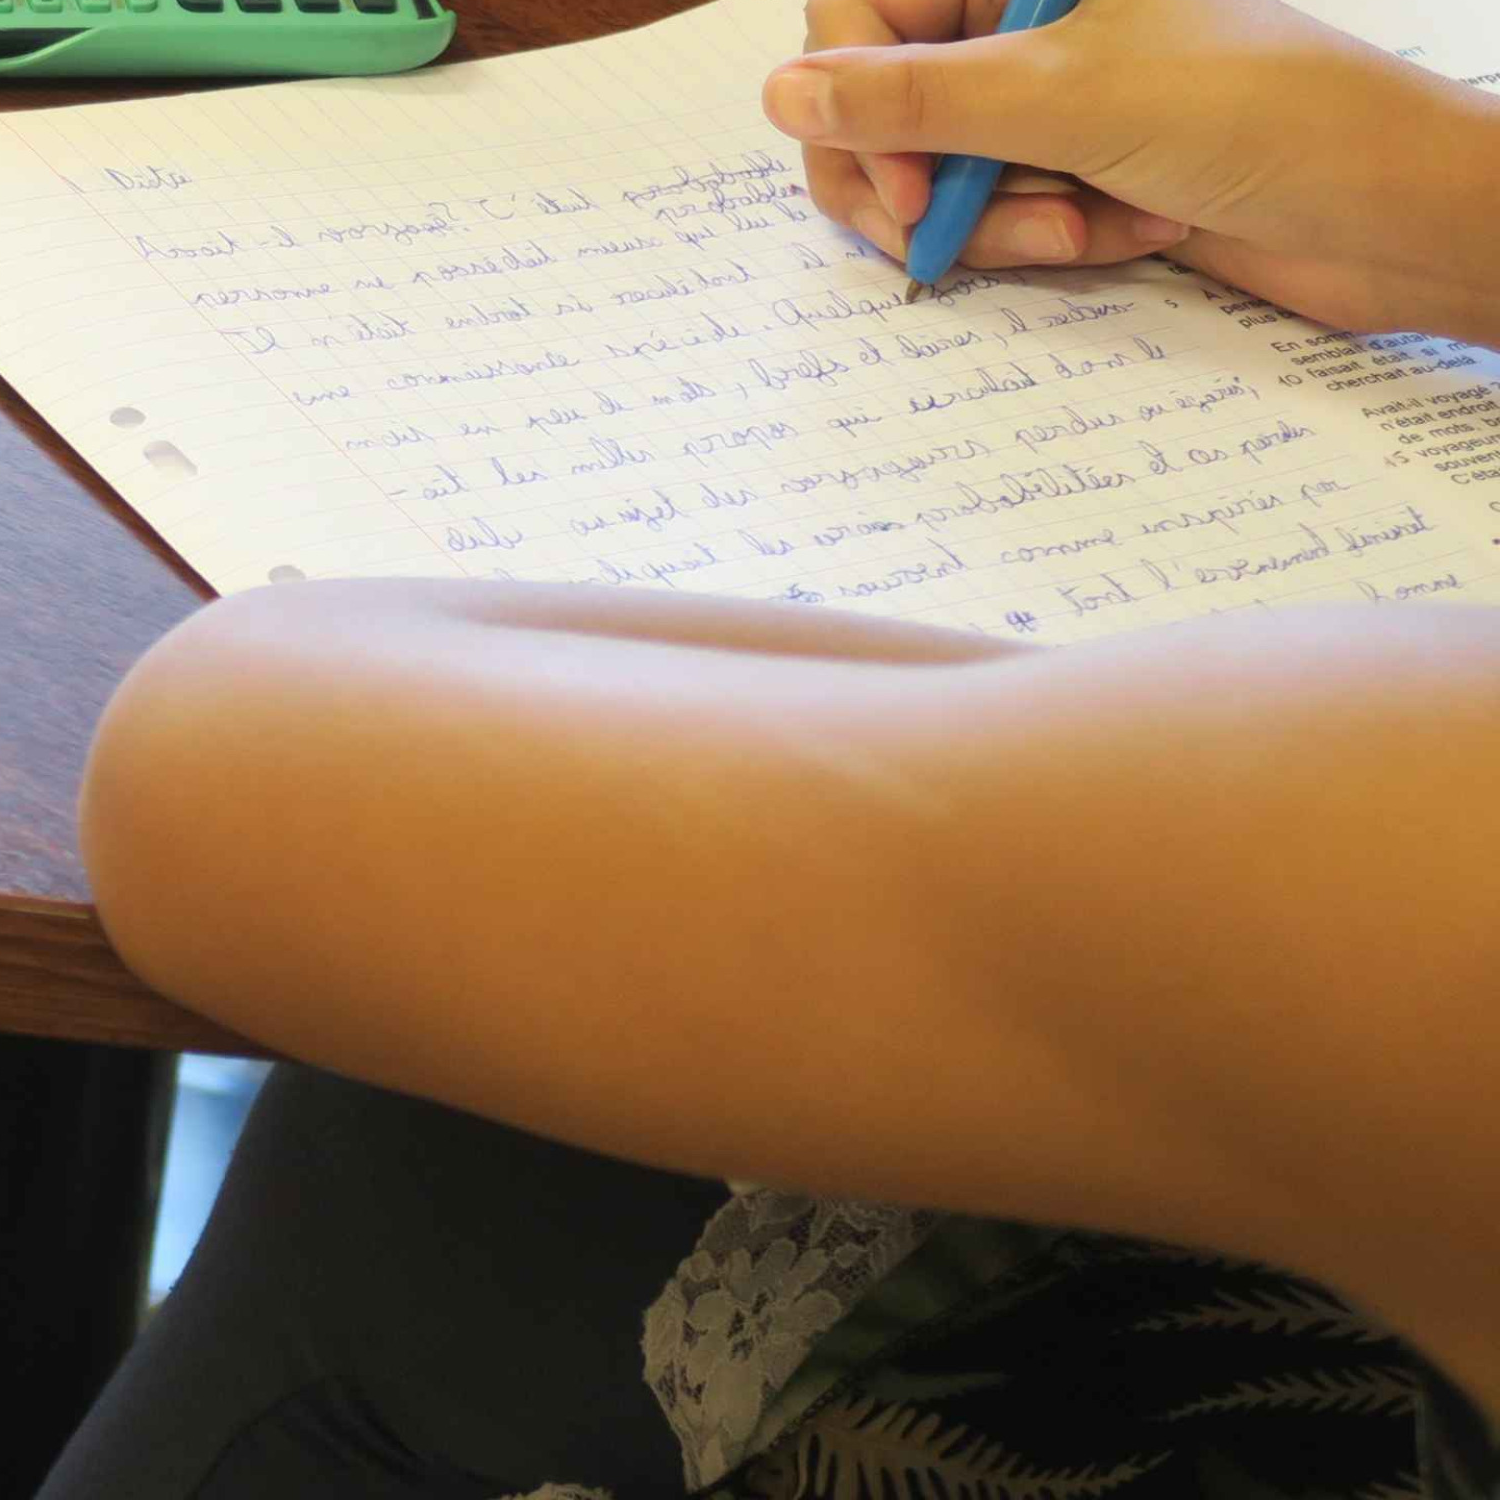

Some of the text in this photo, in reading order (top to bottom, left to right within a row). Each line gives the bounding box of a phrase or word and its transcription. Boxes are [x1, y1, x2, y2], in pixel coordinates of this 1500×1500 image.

[1239, 311, 1278, 330] plus
[1271, 340, 1301, 354] En
[1291, 342, 1367, 365] semblait
[1306, 359, 1366, 380] faisait
[1371, 351, 1414, 367] était
[1326, 367, 1408, 393] cherchait
[1361, 398, 1424, 419] Avait-il
[1380, 412, 1437, 432] n'était
[1398, 431, 1424, 446] de
